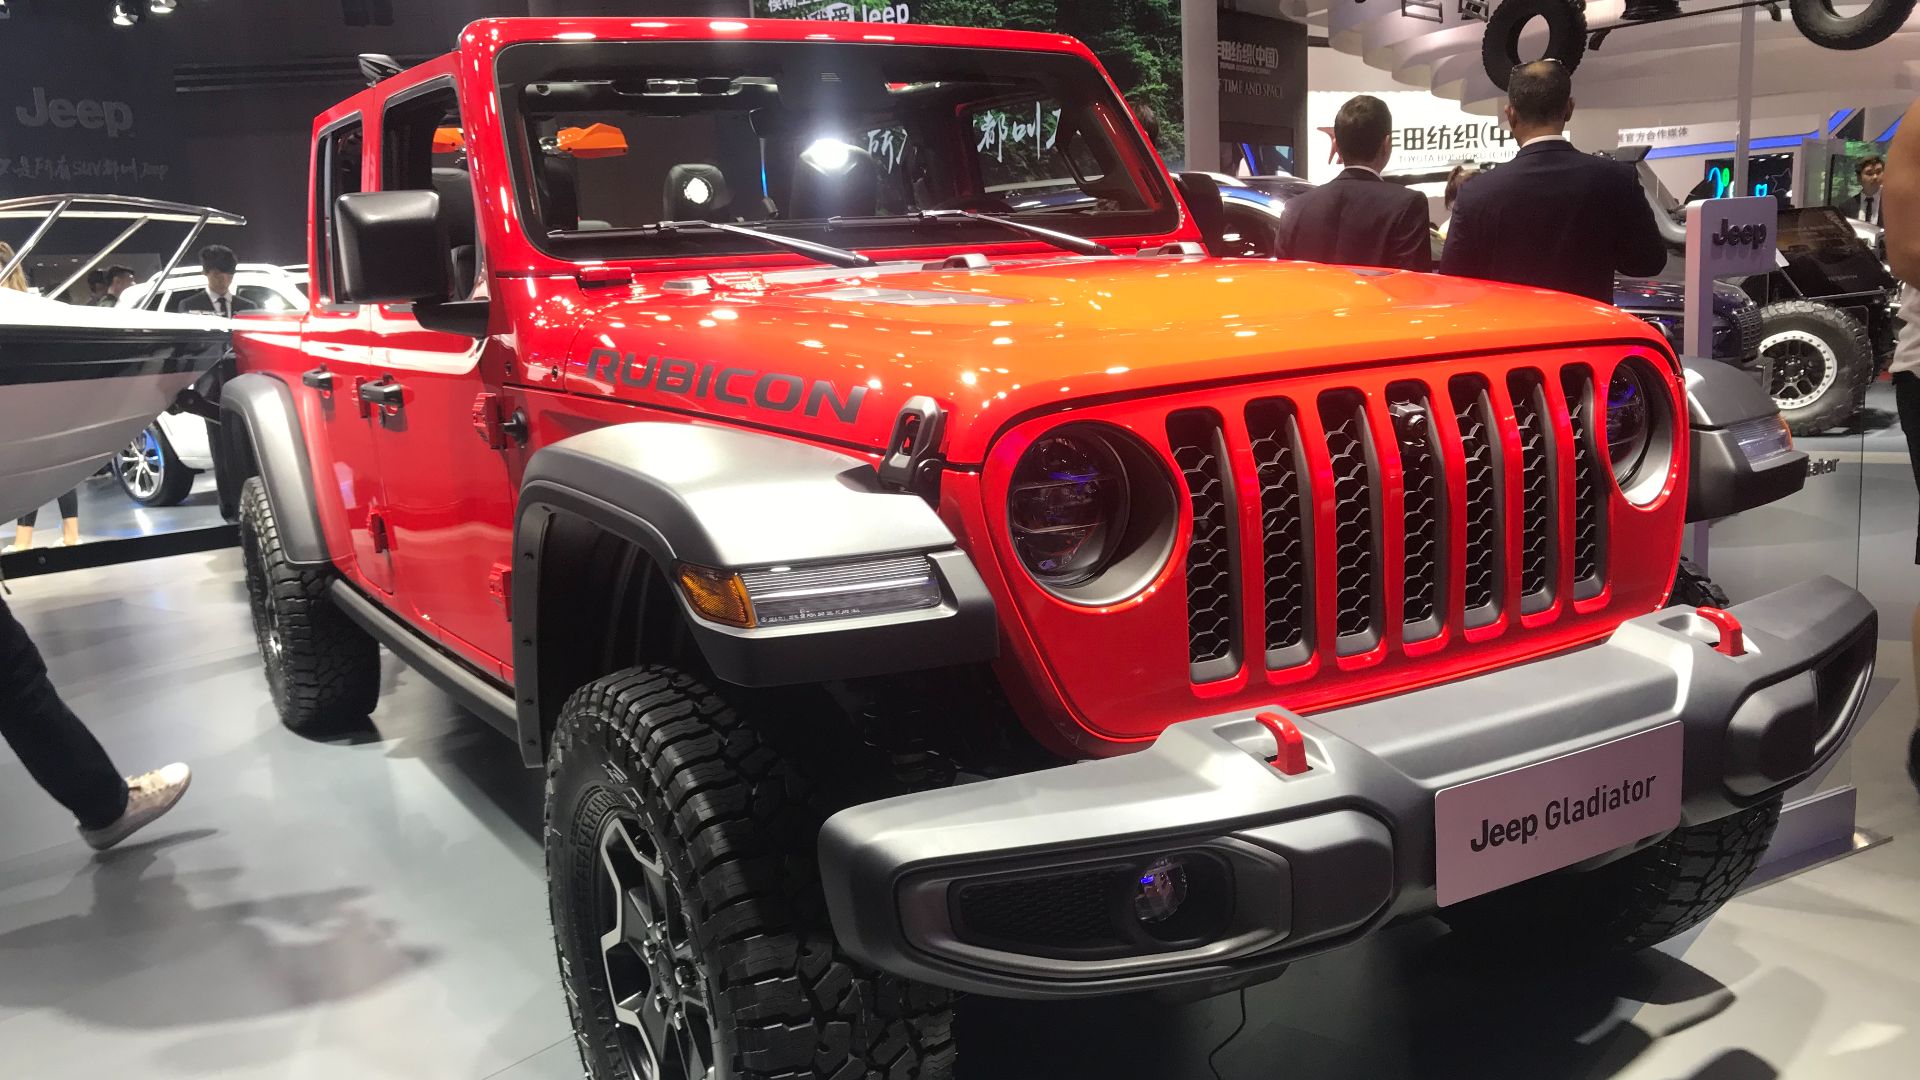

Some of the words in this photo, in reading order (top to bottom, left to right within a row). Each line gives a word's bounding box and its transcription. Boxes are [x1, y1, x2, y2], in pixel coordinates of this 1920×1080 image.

[16, 86, 134, 138] Jeep
[1399, 153, 1434, 163] TOYOTA
[1712, 218, 1767, 249] Jeep
[585, 347, 869, 424] RUBICON
[1470, 813, 1539, 852] Jeep
[1545, 775, 1656, 830] Gladiator
